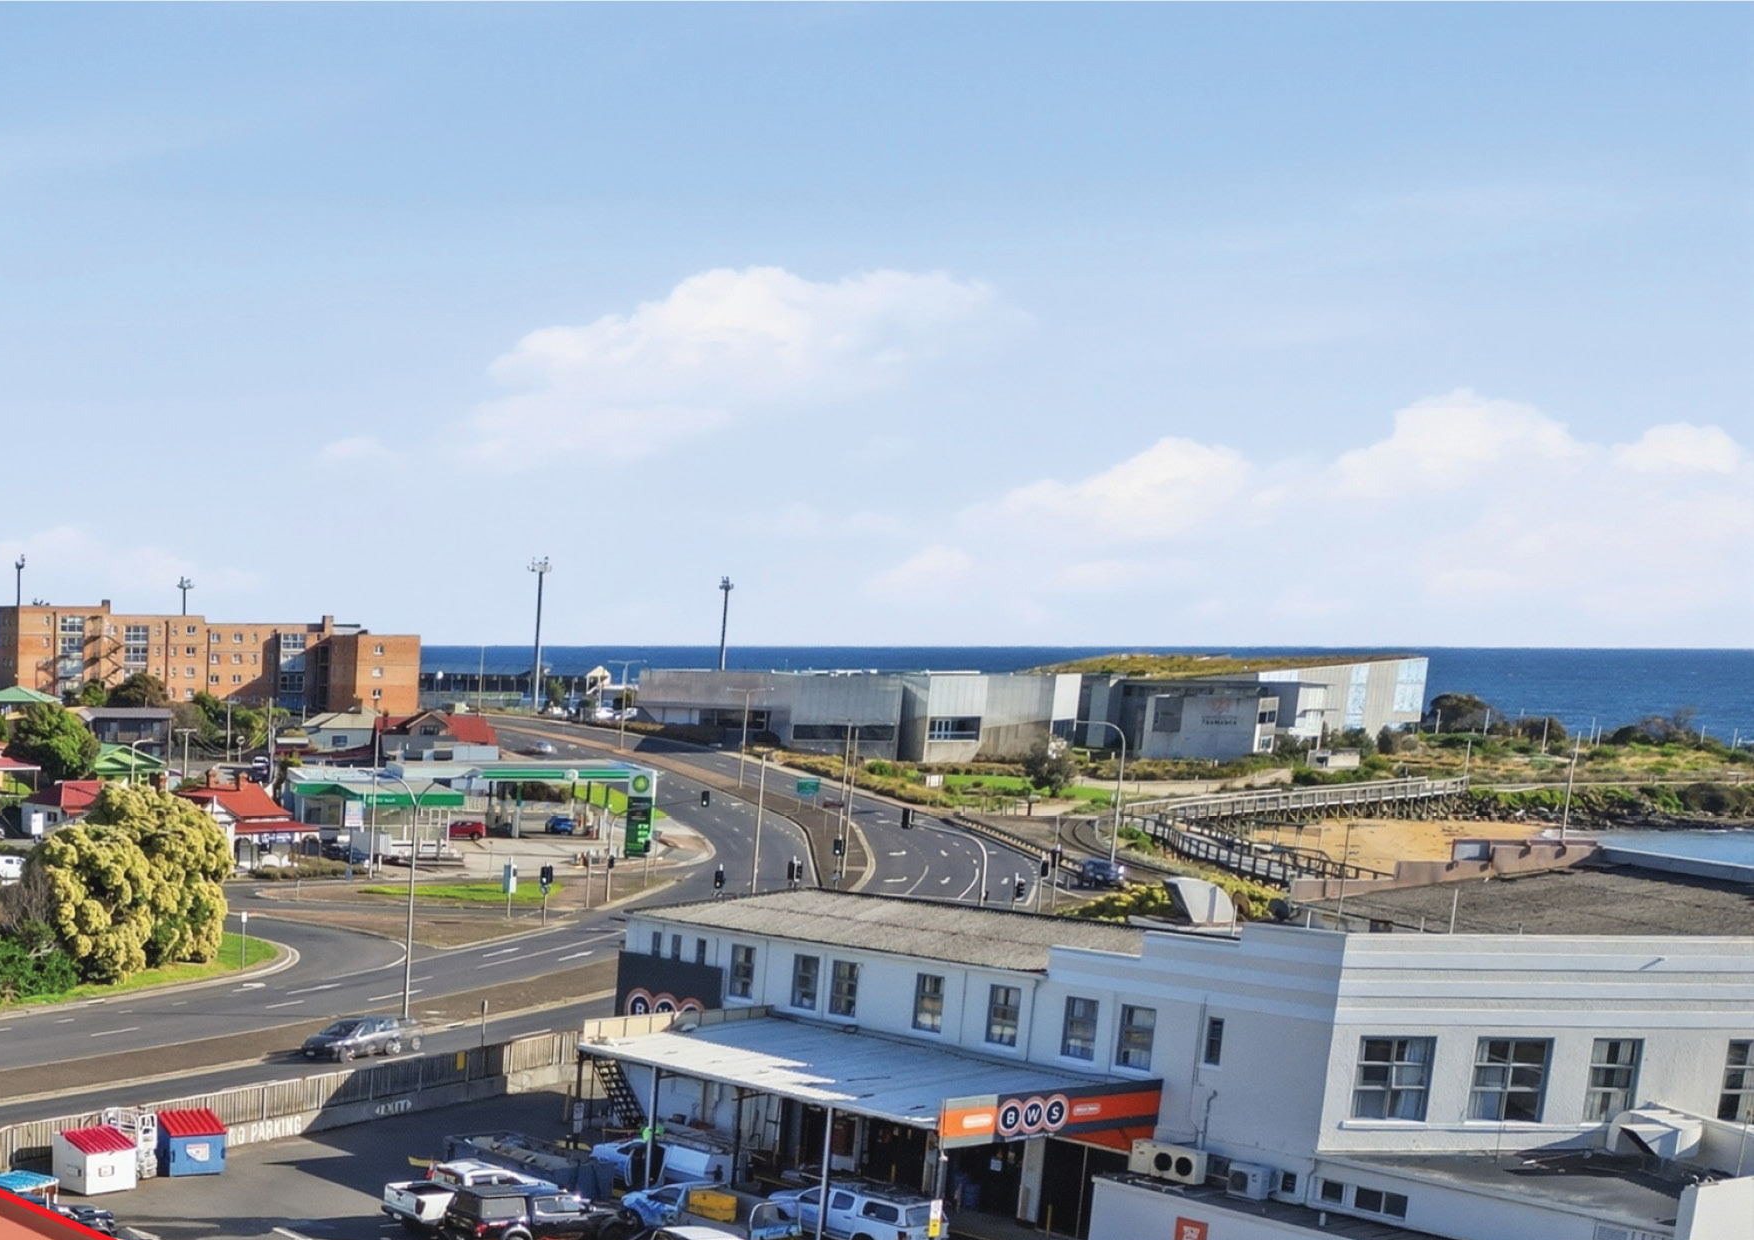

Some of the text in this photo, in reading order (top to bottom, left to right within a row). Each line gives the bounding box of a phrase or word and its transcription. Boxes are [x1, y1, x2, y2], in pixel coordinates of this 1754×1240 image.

[1006, 1105, 1060, 1125] BWS
[228, 1115, 302, 1147] NO PARKING
